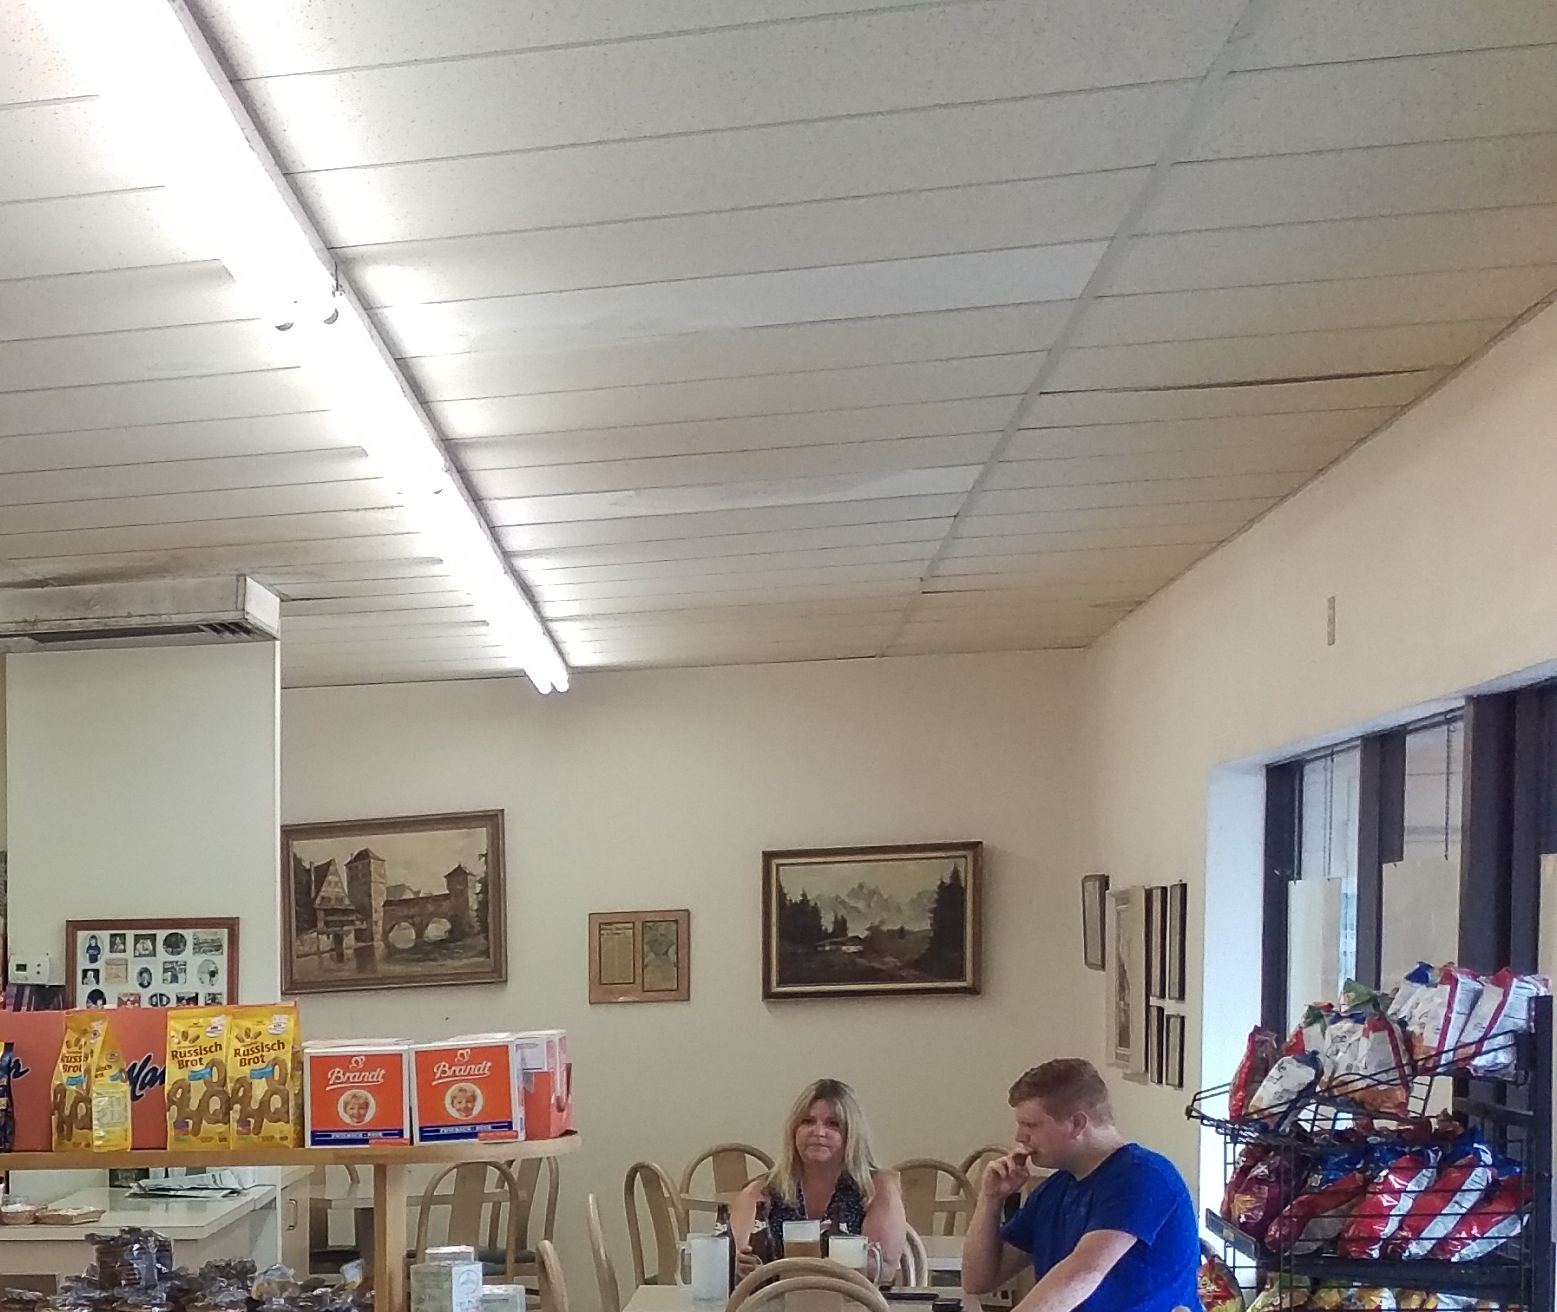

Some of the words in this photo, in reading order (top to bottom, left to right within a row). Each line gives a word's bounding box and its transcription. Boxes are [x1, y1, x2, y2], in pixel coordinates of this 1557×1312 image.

[171, 1041, 223, 1060] Russisch
[233, 1039, 285, 1058] Russisch
[178, 1056, 204, 1070] Brot
[239, 1054, 266, 1068] Brot
[327, 1067, 385, 1085] Brandt
[433, 1061, 493, 1080] Brandt
